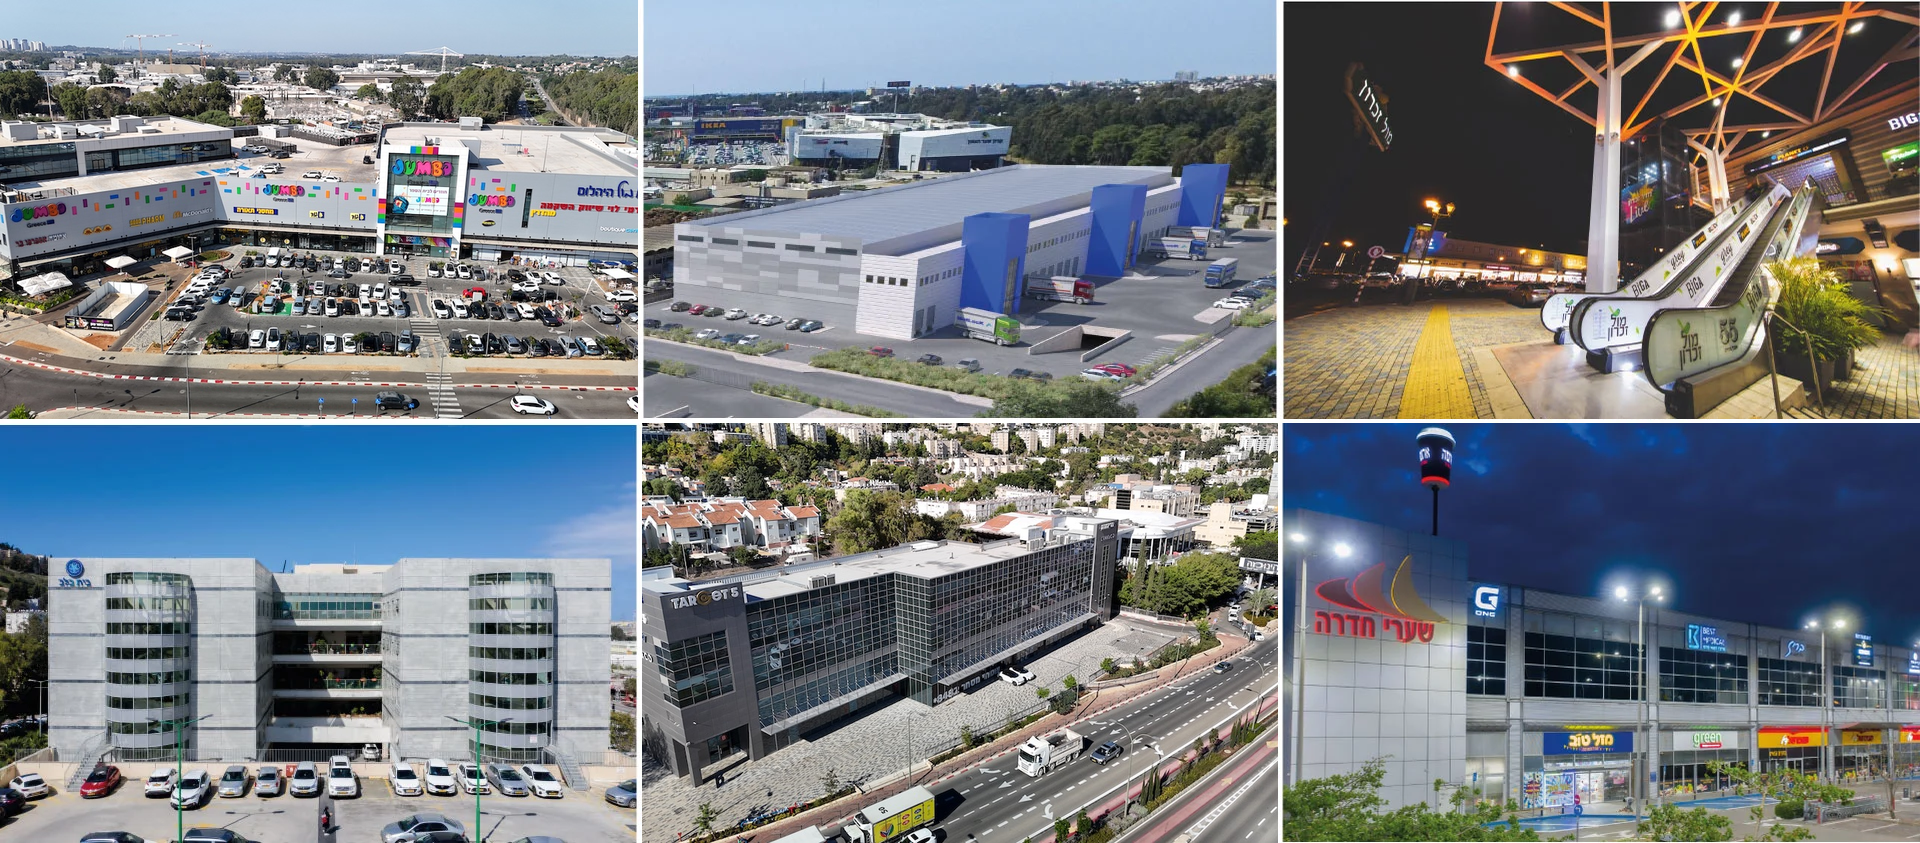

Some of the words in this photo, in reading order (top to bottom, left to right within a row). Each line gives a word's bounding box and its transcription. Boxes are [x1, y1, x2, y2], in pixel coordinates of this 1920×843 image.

[1359, 79, 1382, 122] זכרון
[1381, 117, 1393, 145] מול
[1777, 148, 1802, 160] PLANET
[391, 158, 453, 177] JUMBO
[263, 184, 305, 197] JUMBO
[577, 185, 614, 198] היהלום
[415, 196, 440, 204] JUMBO
[468, 193, 515, 207] JUMBO
[540, 202, 575, 211] השקמה
[10, 202, 67, 223] JUMBO
[182, 207, 213, 218] McDonald's
[578, 204, 604, 212] שיווק
[607, 205, 620, 213] לוי
[142, 214, 165, 225] PHARM
[1670, 250, 1686, 271] grey
[1720, 243, 1733, 266] grey
[1631, 279, 1650, 297] BIGA
[1685, 276, 1704, 299] BIGA
[1745, 283, 1762, 314] BIGA
[1610, 313, 1627, 327] מול
[1607, 326, 1629, 342] זכרון
[1681, 330, 1699, 349] מול
[1679, 346, 1702, 371] זכרון
[76, 579, 92, 587] בית
[731, 587, 739, 598] 5
[1475, 586, 1500, 611] G
[1314, 610, 1376, 639] חדרה
[1382, 618, 1435, 643] שערי
[1702, 626, 1716, 635] BEST
[960, 676, 981, 691] מסחר
[1568, 733, 1592, 748] טוב
[1692, 732, 1722, 748] green
